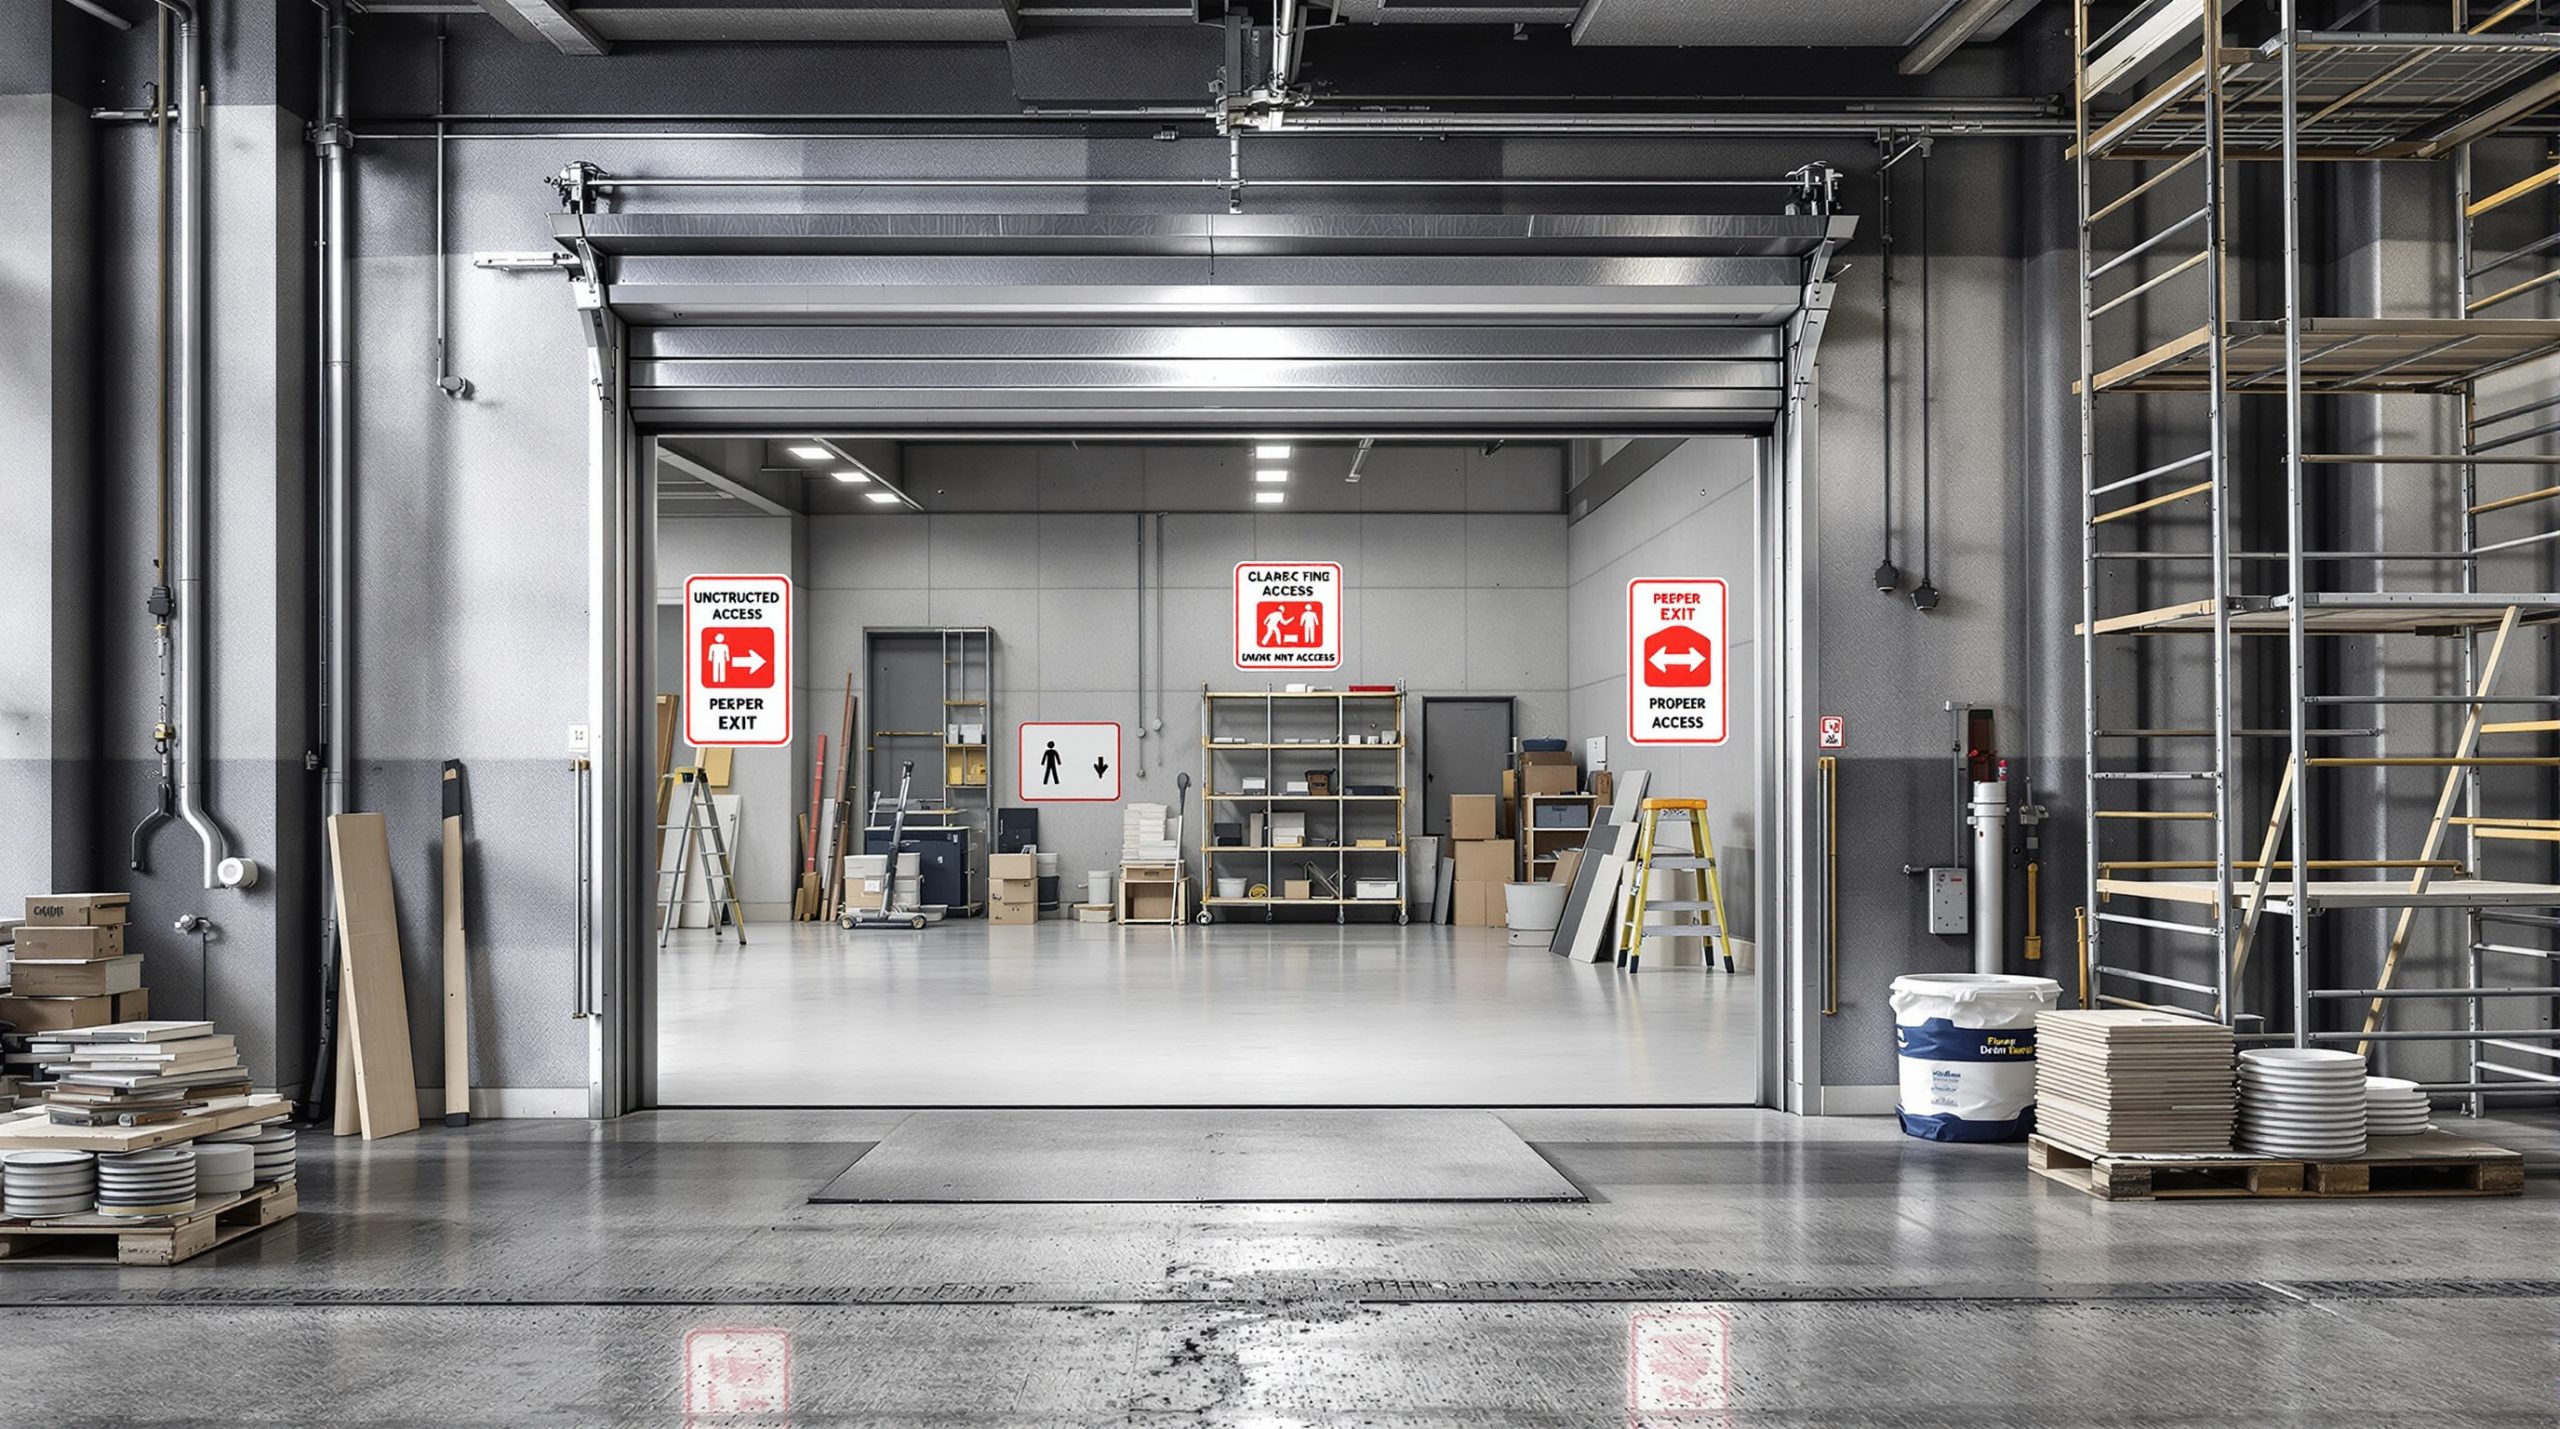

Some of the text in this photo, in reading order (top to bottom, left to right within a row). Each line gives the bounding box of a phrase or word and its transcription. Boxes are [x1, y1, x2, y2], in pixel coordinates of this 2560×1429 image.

[1262, 585, 1314, 596] ACCESS
[693, 591, 780, 604] UNCTRUCTED
[712, 608, 763, 620] ACCESS
[1661, 607, 1696, 621] EXIT
[1649, 697, 1706, 709] PROPEER
[718, 715, 758, 730] EXIT
[1651, 716, 1704, 729] ACCESS
